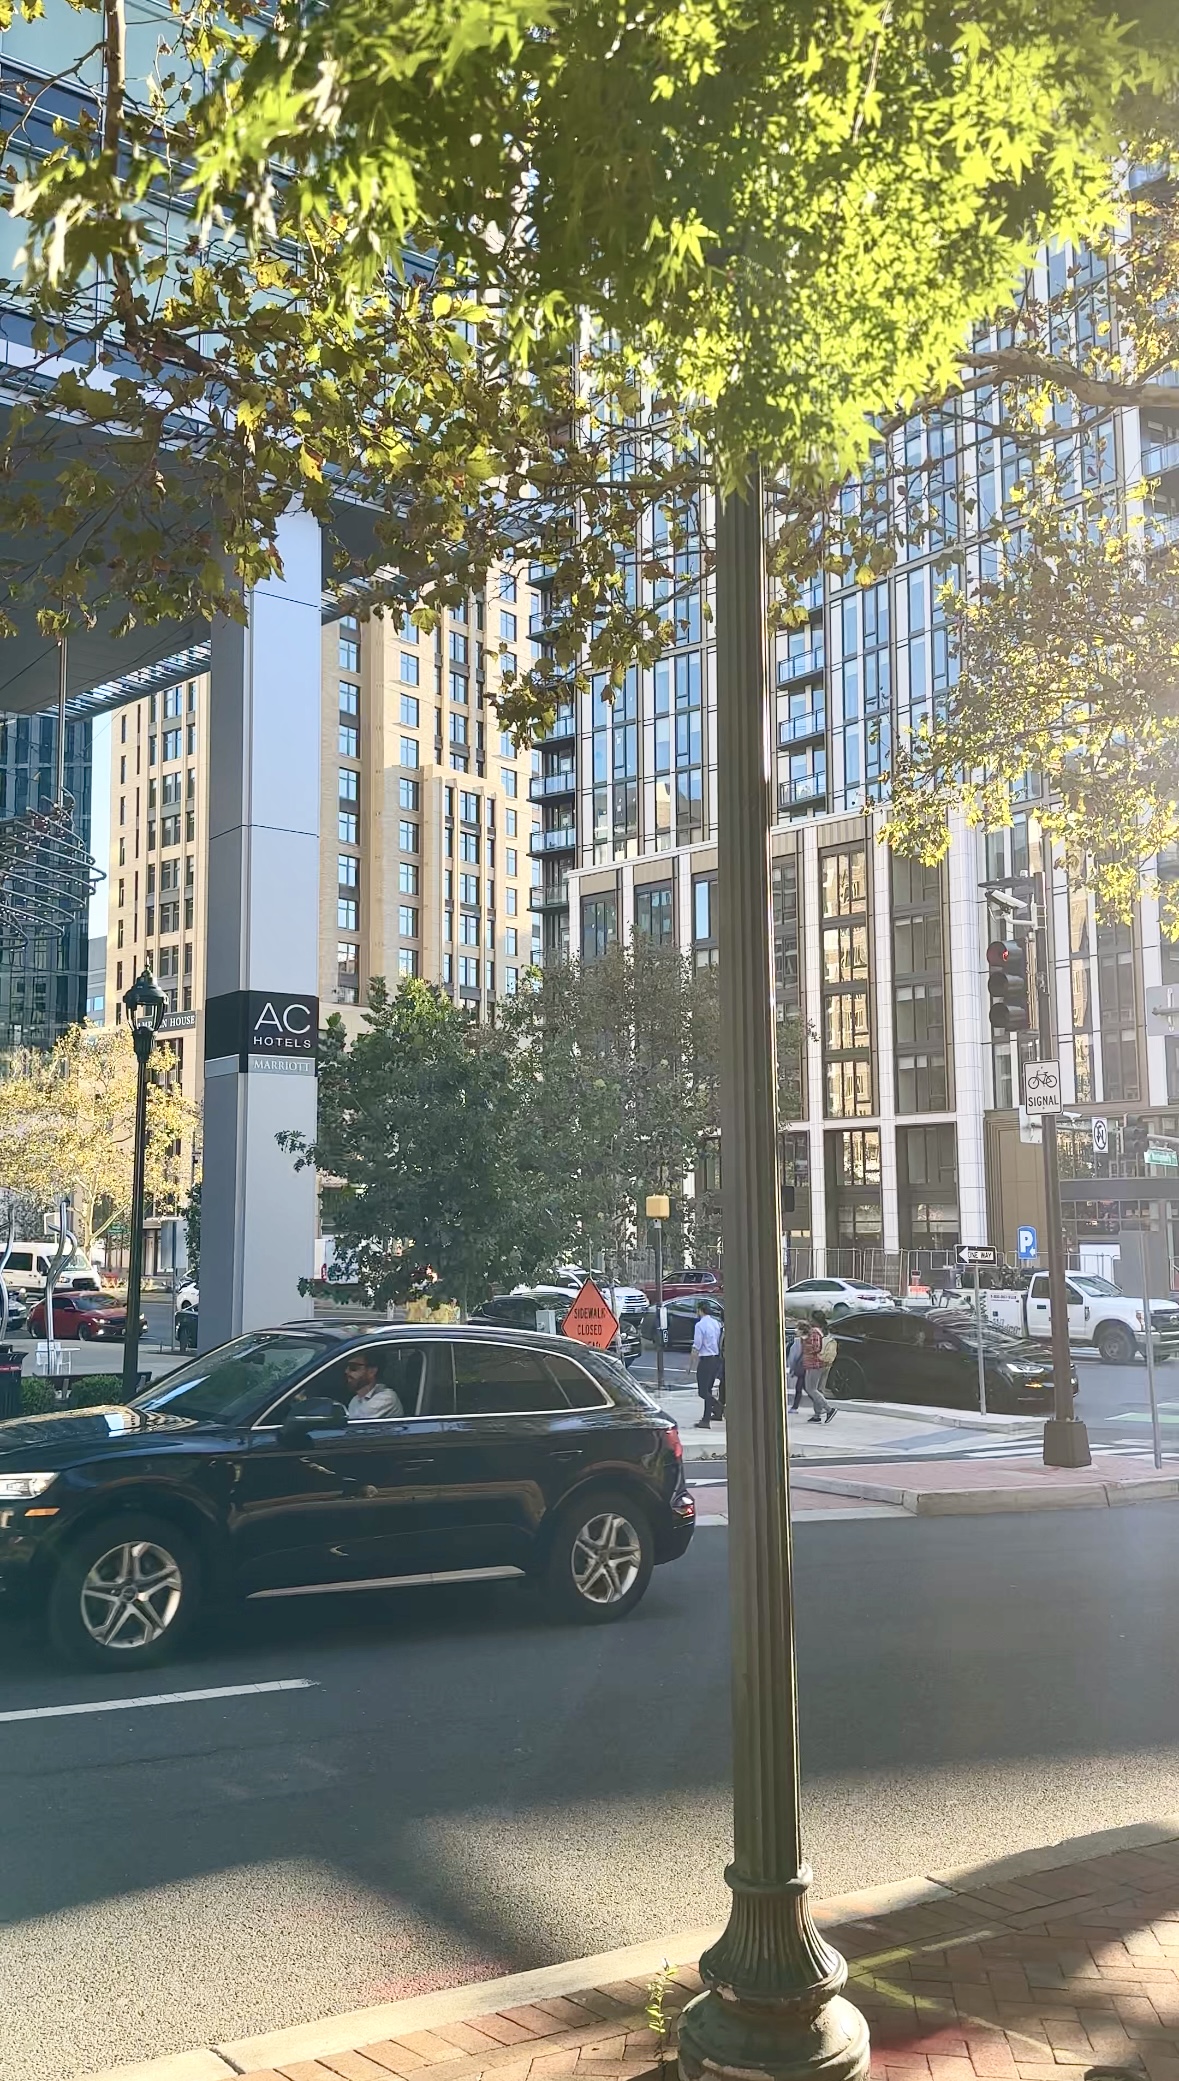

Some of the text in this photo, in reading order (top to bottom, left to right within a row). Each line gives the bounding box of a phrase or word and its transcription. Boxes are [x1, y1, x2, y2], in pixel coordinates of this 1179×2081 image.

[170, 1015, 195, 1027] HOUSE
[254, 1002, 311, 1034] AC
[253, 1036, 311, 1049] HOTELS
[254, 1060, 311, 1072] MARRIOTT
[1028, 1095, 1059, 1107] SIGNAL
[1020, 1230, 1033, 1253] P
[967, 1251, 992, 1259] ONE WAY
[573, 1307, 606, 1319] SIDEWALK
[577, 1324, 603, 1336] CLOSED
